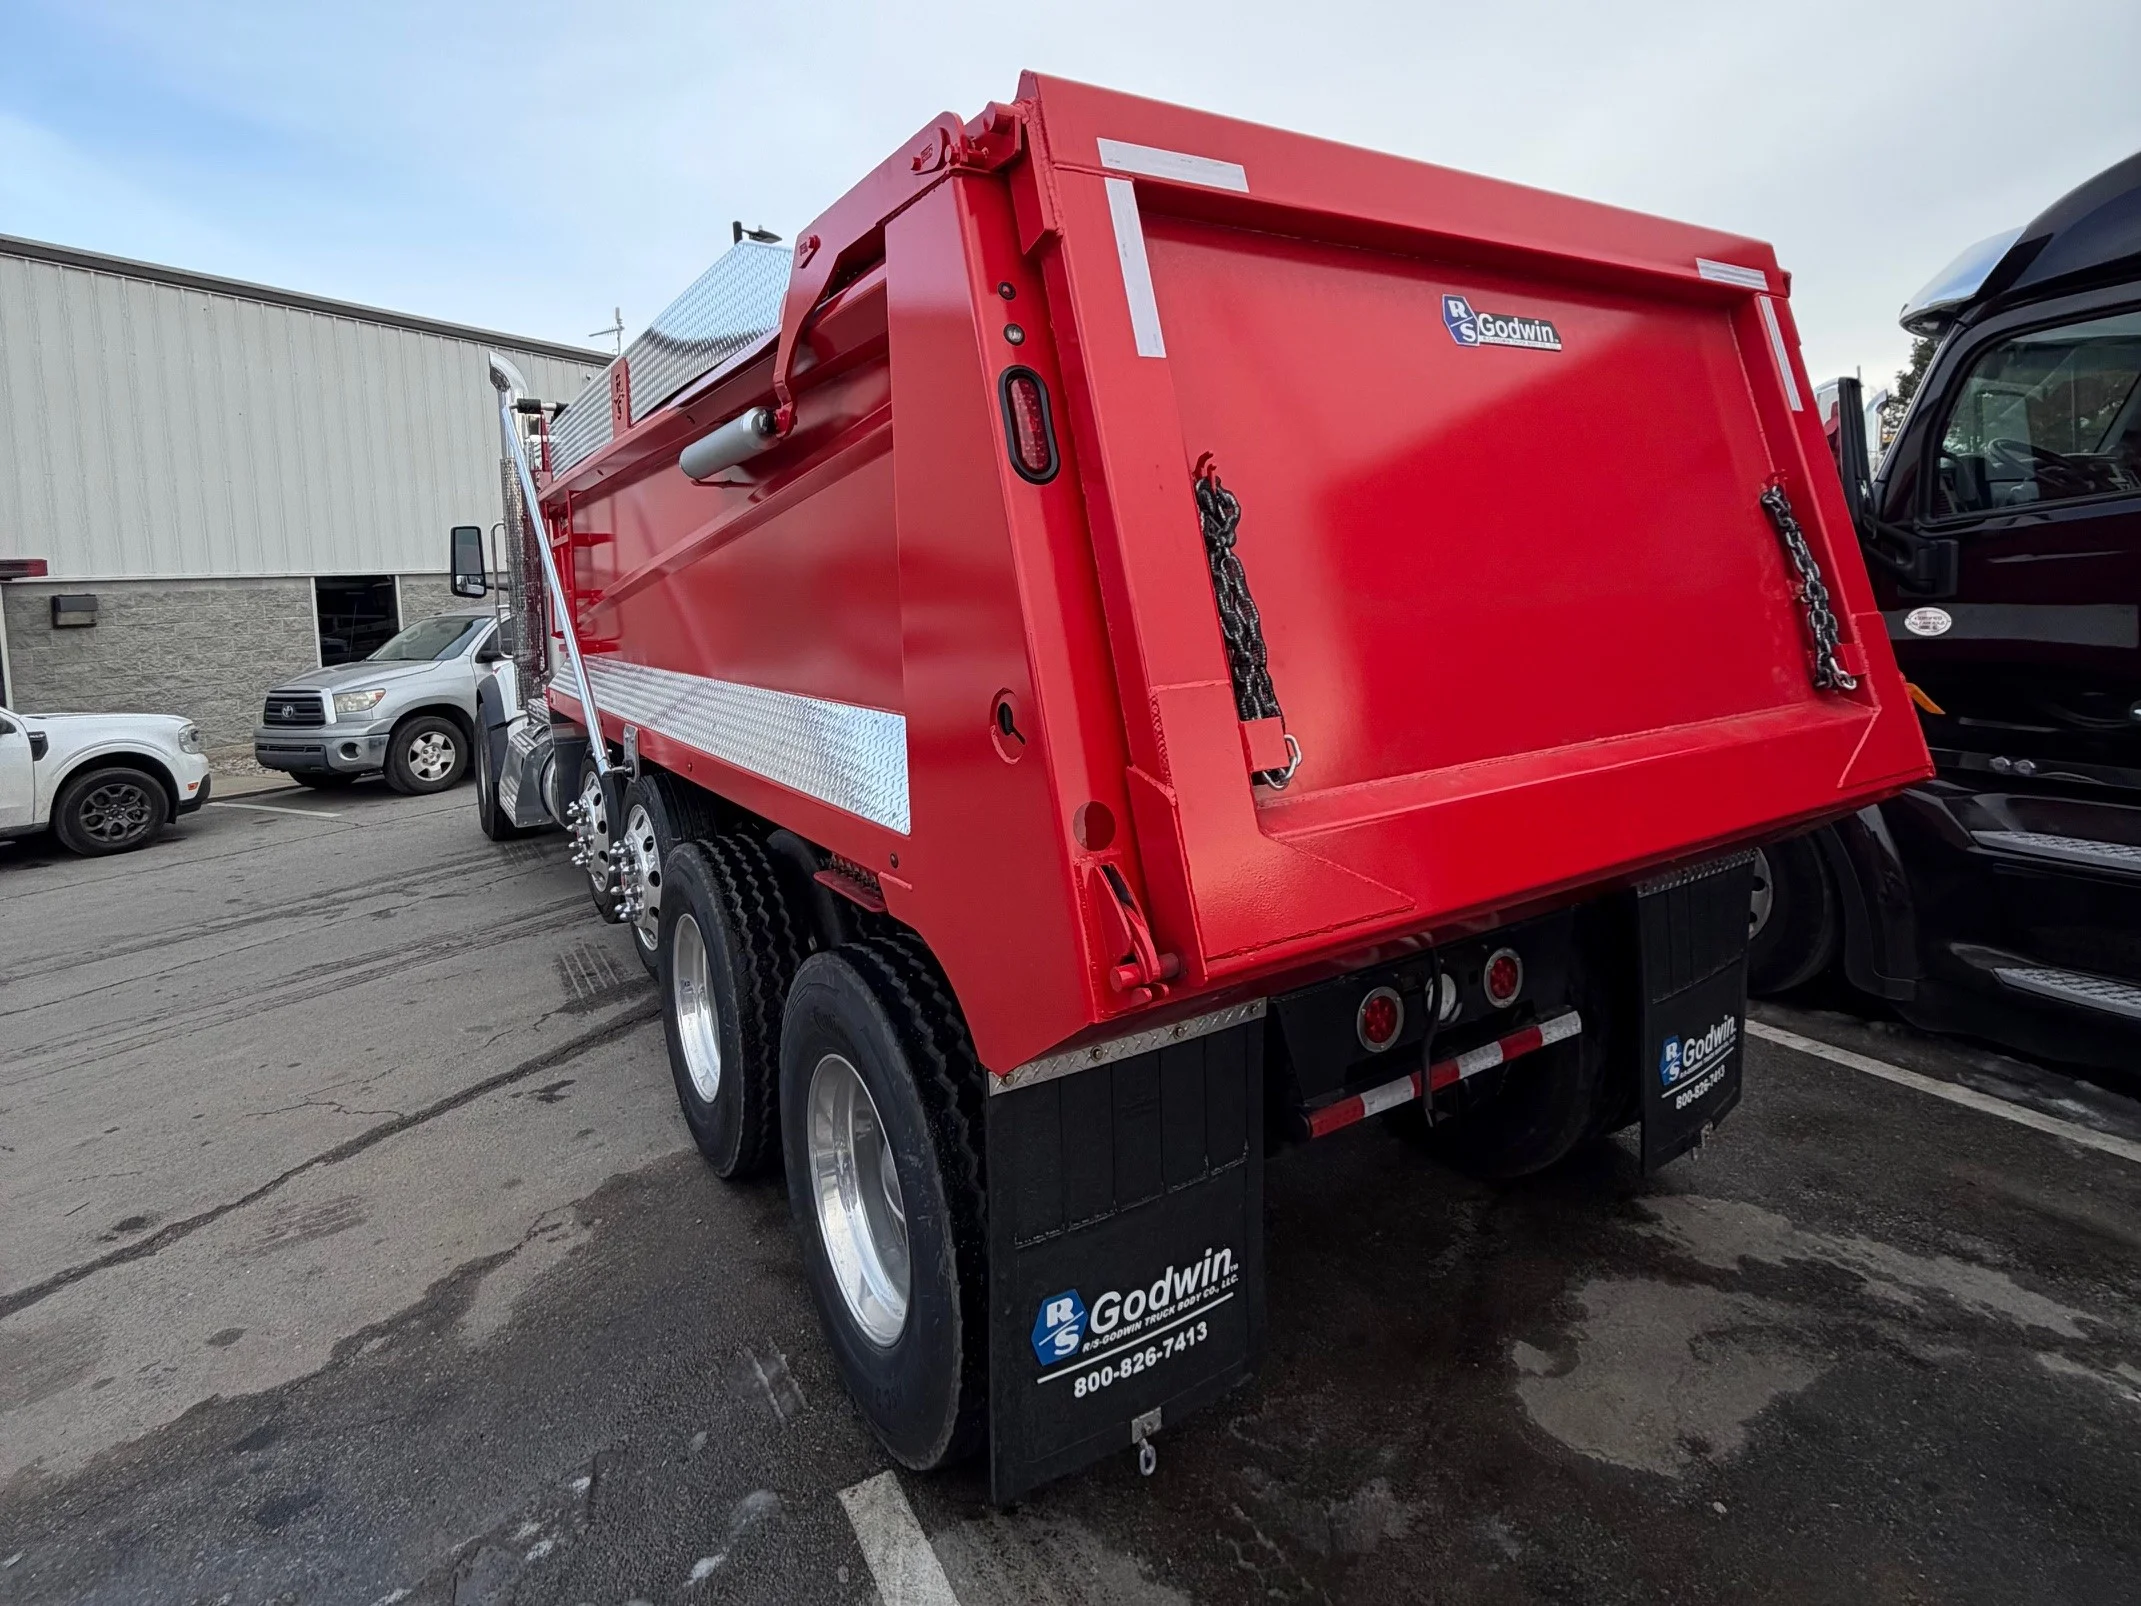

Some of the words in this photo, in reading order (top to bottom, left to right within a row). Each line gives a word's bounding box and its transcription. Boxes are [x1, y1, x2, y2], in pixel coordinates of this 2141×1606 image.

[1478, 313, 1554, 343] Godwin
[1683, 1015, 1734, 1067] Godwin
[1090, 1247, 1232, 1334] Godwin
[1082, 1320, 1143, 1353] R/S-GODWIN
[1144, 1305, 1176, 1327] TRUCK
[1177, 1292, 1202, 1312] BODY
[1073, 1321, 1208, 1398] 800-826-7413
